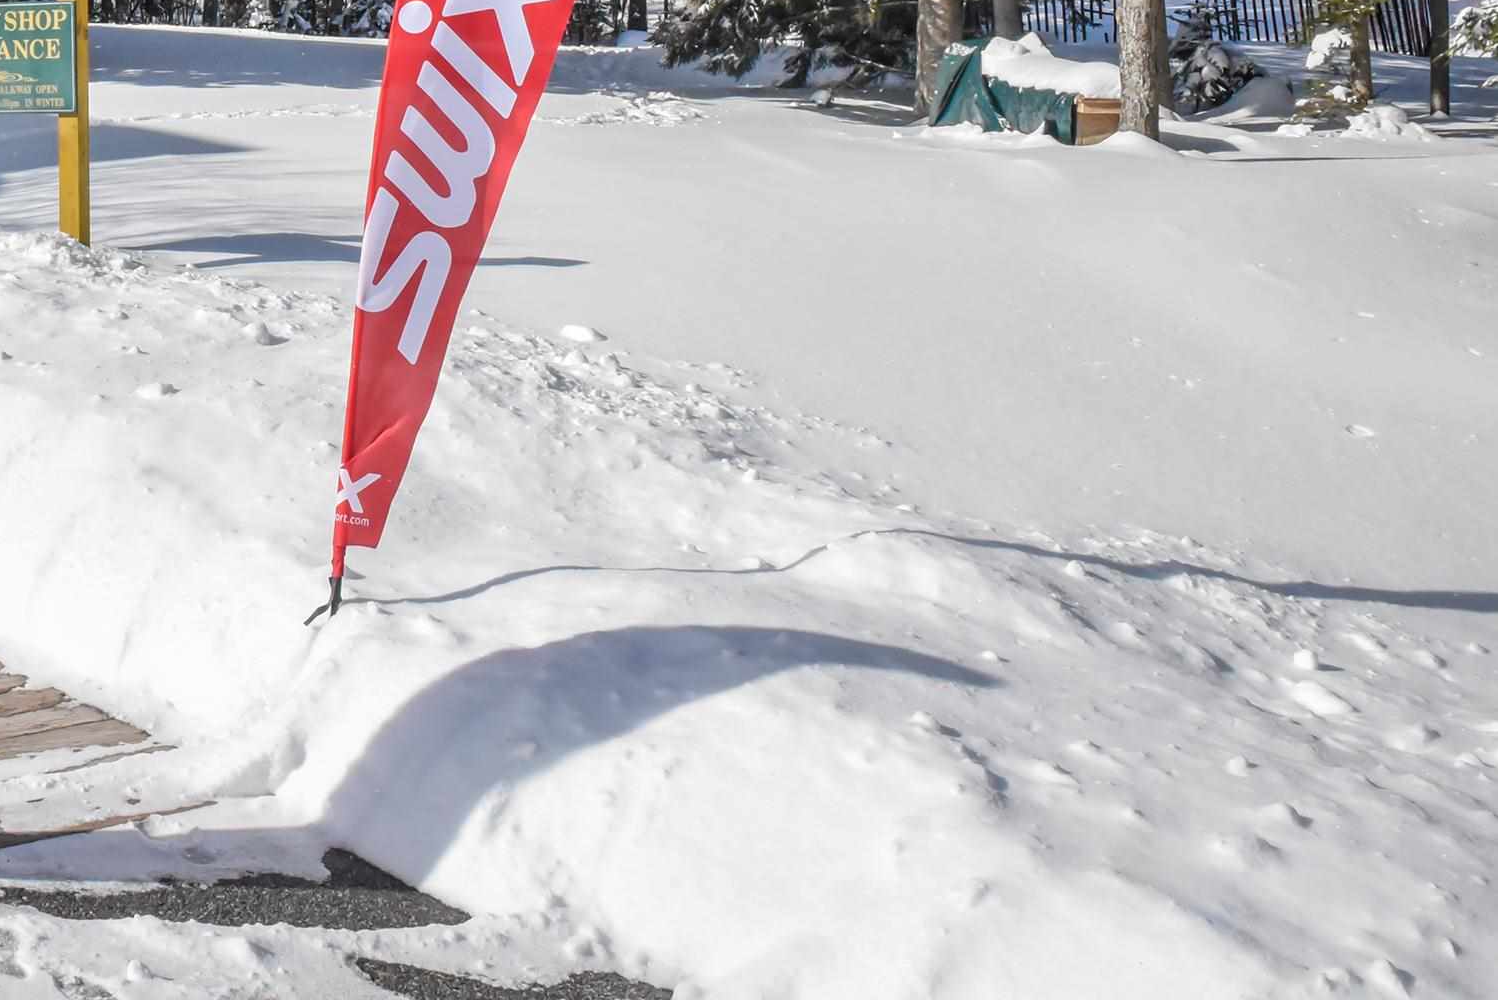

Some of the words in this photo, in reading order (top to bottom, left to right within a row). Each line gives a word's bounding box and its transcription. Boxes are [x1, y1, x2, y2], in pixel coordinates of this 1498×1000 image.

[4, 9, 68, 32] SHOP
[35, 85, 58, 95] OPEN
[36, 98, 65, 107] WINTER
